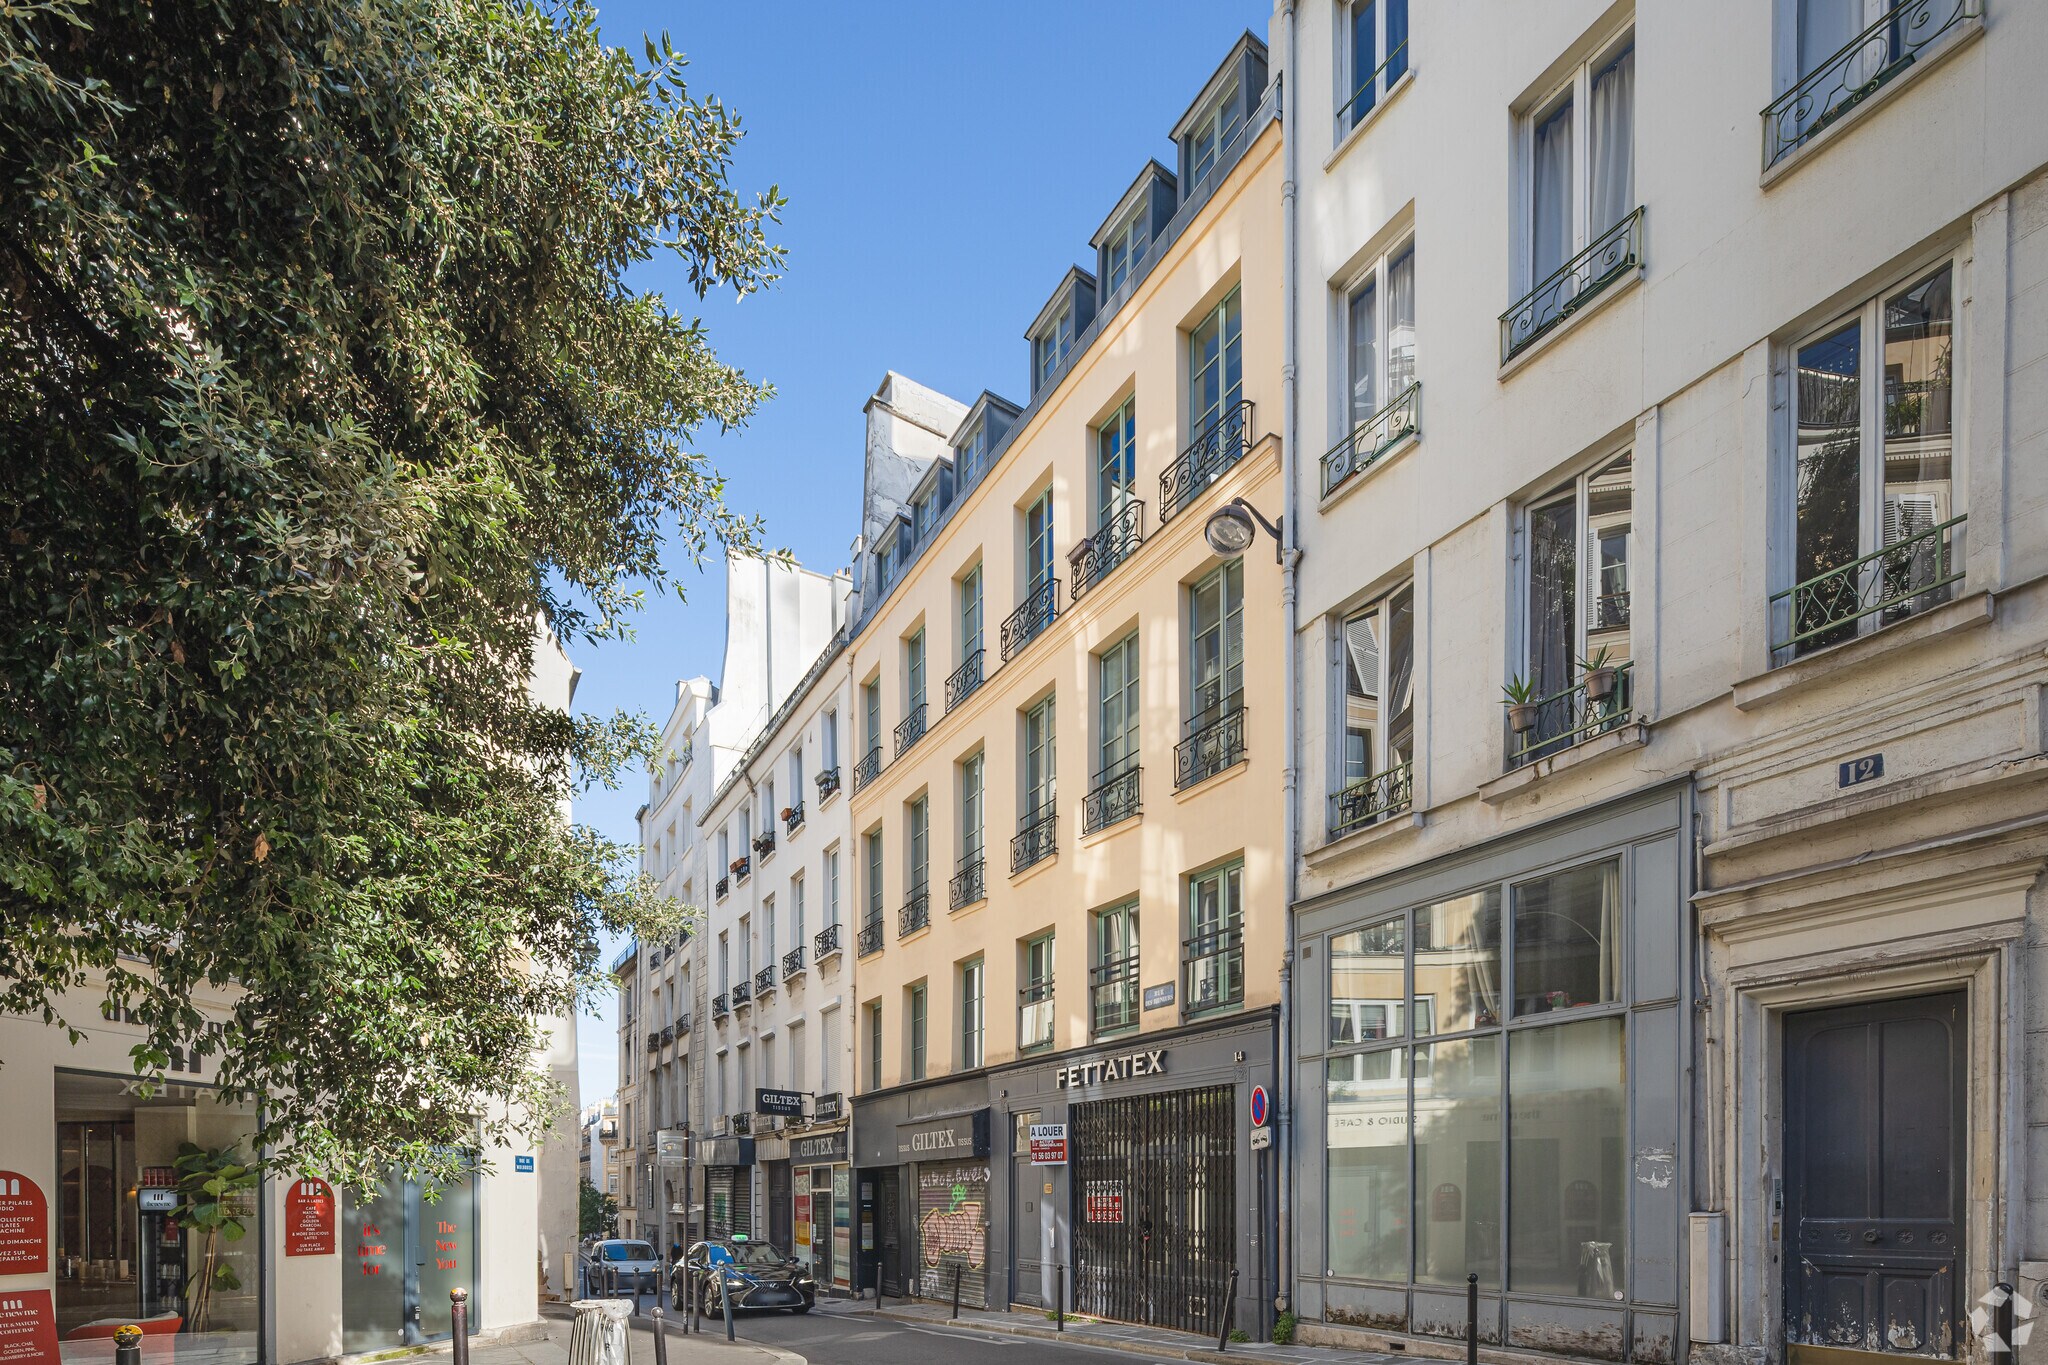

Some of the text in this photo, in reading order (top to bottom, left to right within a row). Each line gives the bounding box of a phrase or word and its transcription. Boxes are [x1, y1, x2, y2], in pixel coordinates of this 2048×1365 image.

[1848, 759, 1874, 784] 12
[1234, 1051, 1243, 1062] 14
[1056, 1050, 1164, 1089] FETTATEX
[763, 1094, 801, 1106] GILTEX
[816, 1101, 837, 1115] GILTEX
[1031, 1126, 1063, 1137] A LOUER
[800, 1137, 834, 1157] GILTEX
[912, 1129, 955, 1152] GILTEX
[957, 1137, 972, 1147] TISSUS
[363, 1223, 380, 1237] it's
[436, 1220, 456, 1234] The
[358, 1242, 386, 1257] time
[435, 1239, 456, 1252] New
[363, 1262, 381, 1275] for
[436, 1258, 456, 1270] You
